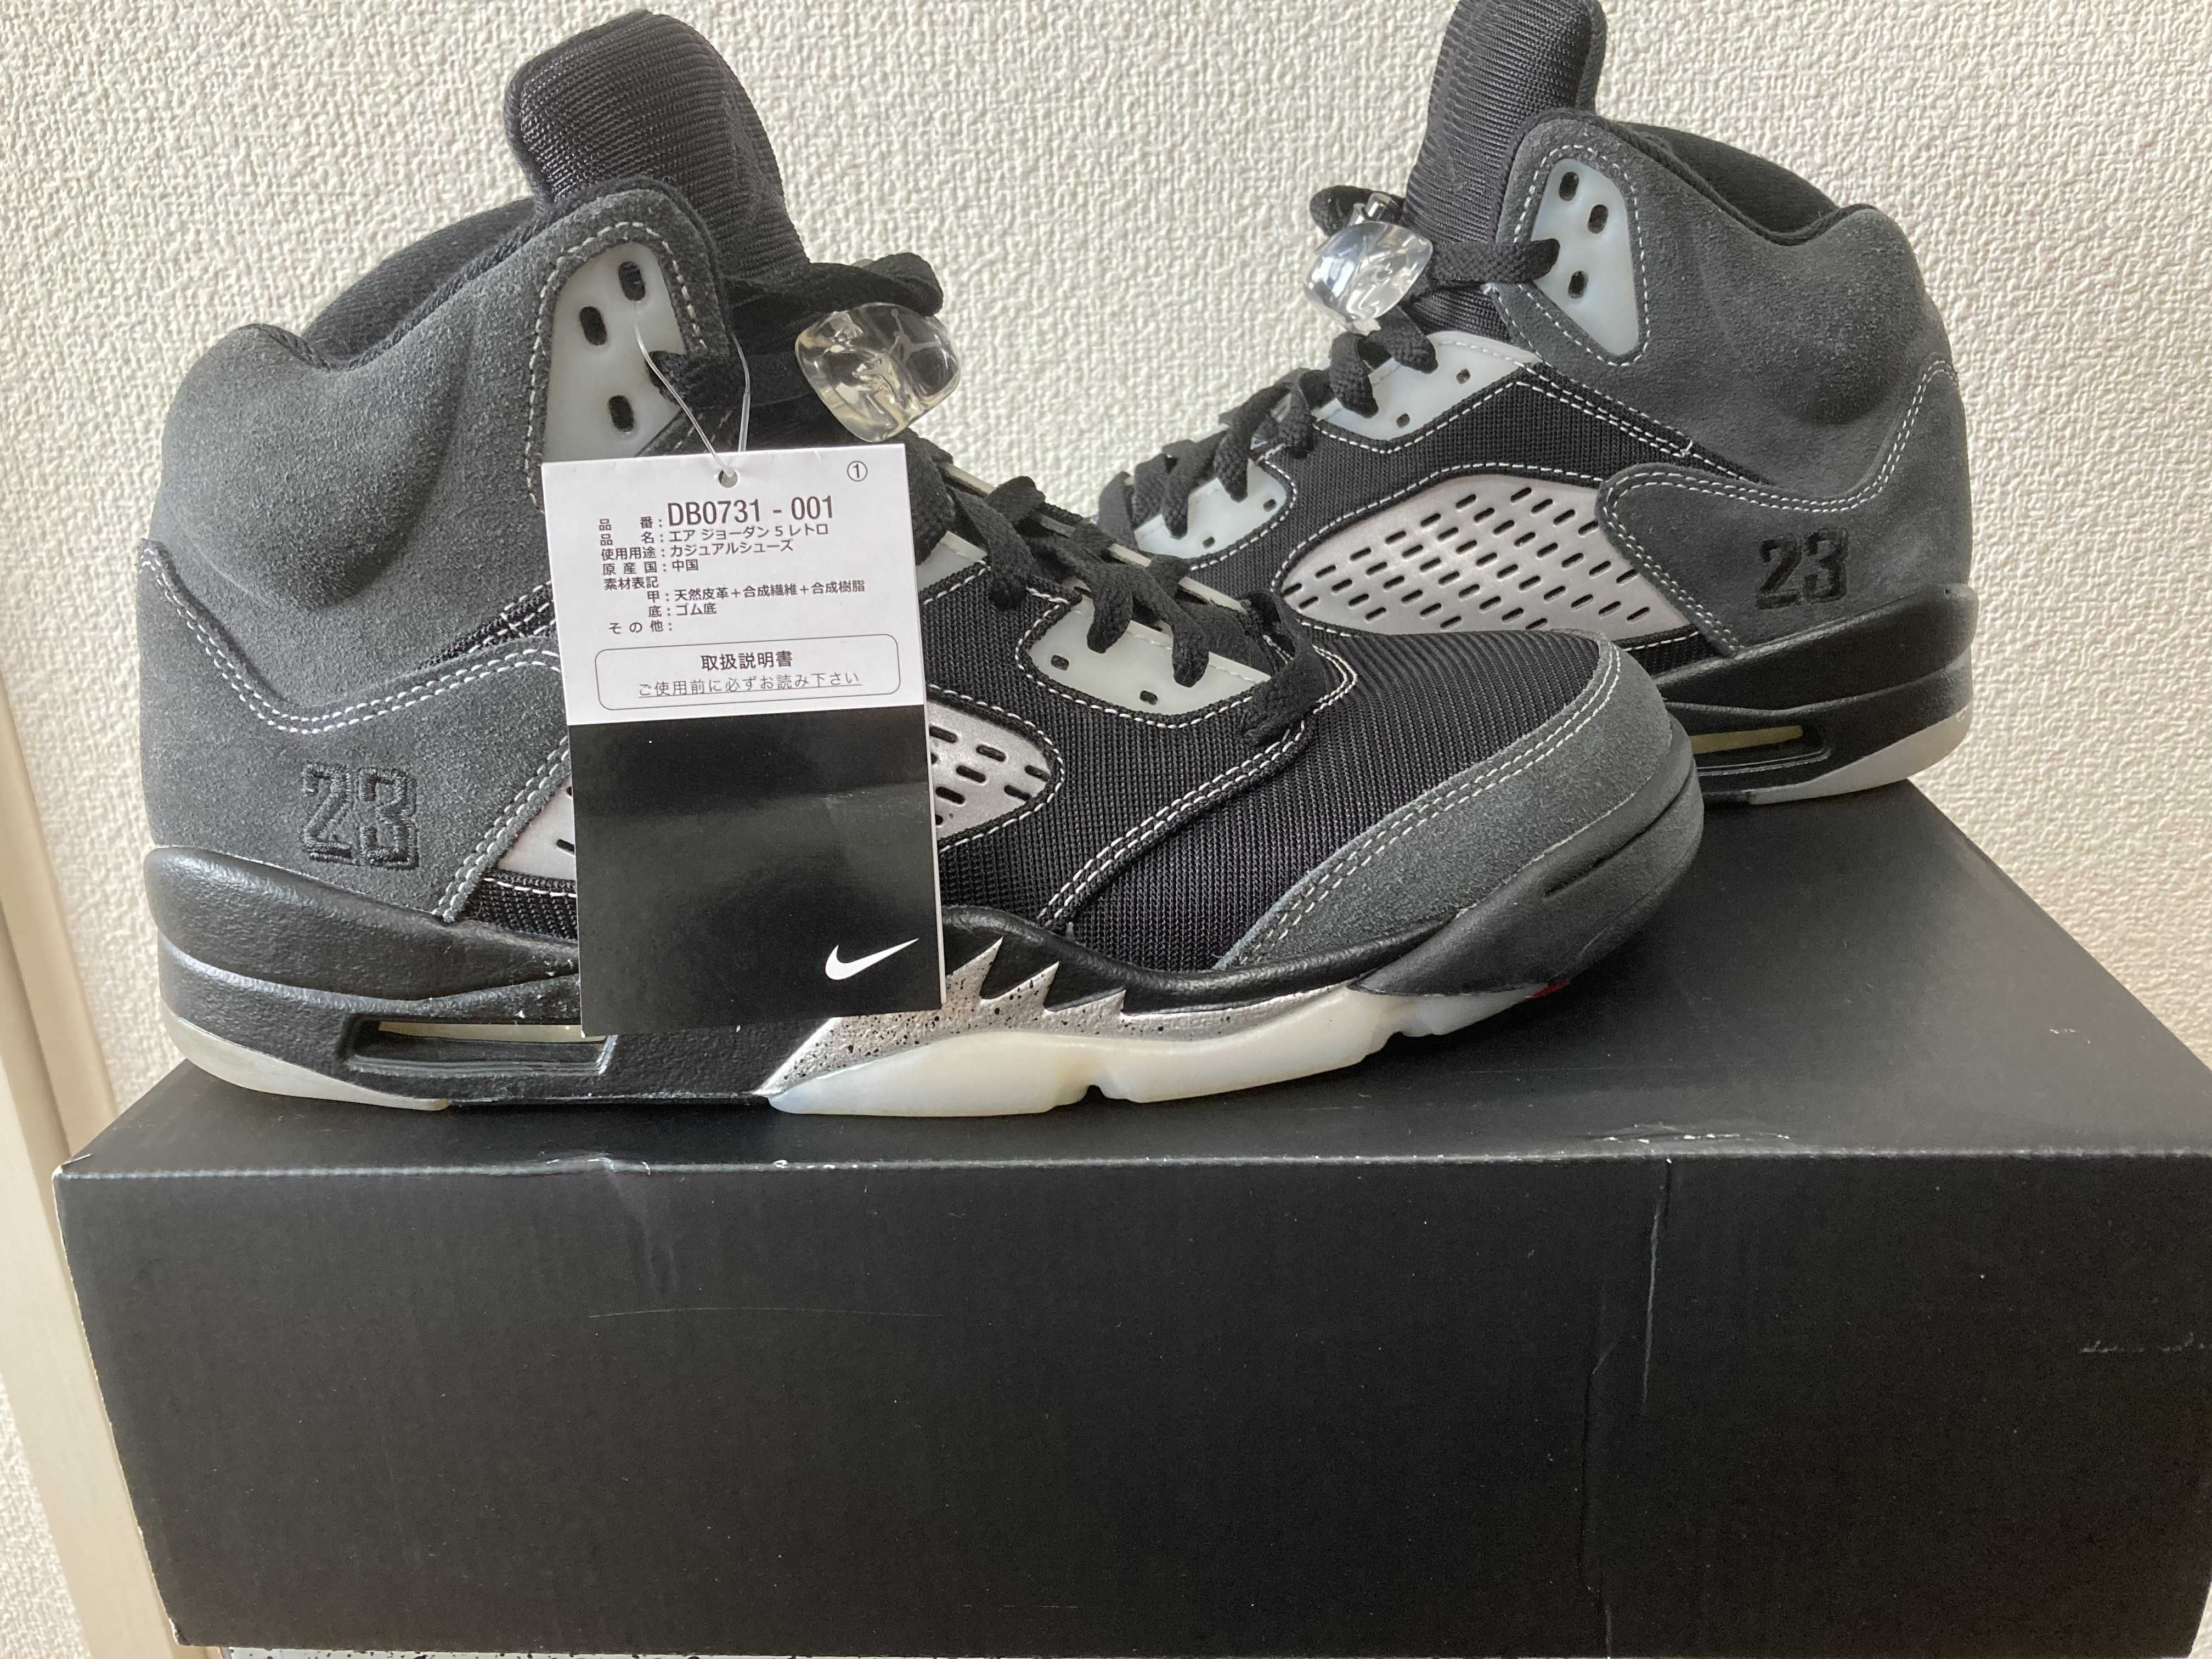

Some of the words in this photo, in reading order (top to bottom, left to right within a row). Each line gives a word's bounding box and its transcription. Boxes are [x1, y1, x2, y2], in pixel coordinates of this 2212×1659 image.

[667, 499, 760, 527] DB0731
[791, 495, 832, 521] 001
[1756, 528, 1848, 610] 23
[603, 575, 659, 590] 素材表記
[676, 602, 717, 616] ゴム底
[700, 650, 793, 672] 取扱説明書
[639, 671, 860, 696] ご使用前に必ずお読み下さい
[302, 763, 420, 870] 23
